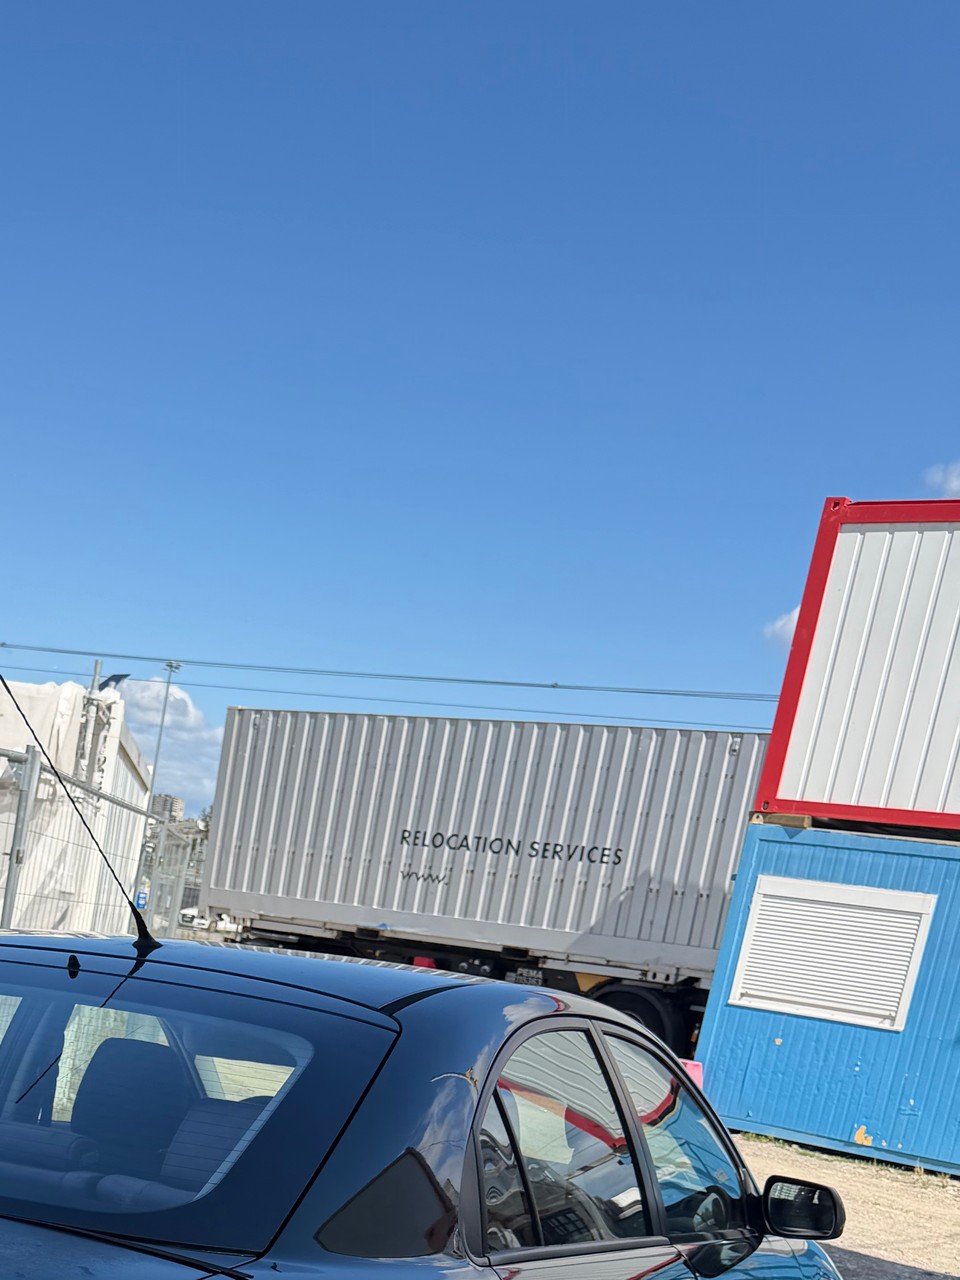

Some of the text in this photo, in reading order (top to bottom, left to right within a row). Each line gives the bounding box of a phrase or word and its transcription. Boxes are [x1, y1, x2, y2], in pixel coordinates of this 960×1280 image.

[400, 829, 623, 866] RELOCATION SERVICES
[517, 968, 543, 979] PEMA
